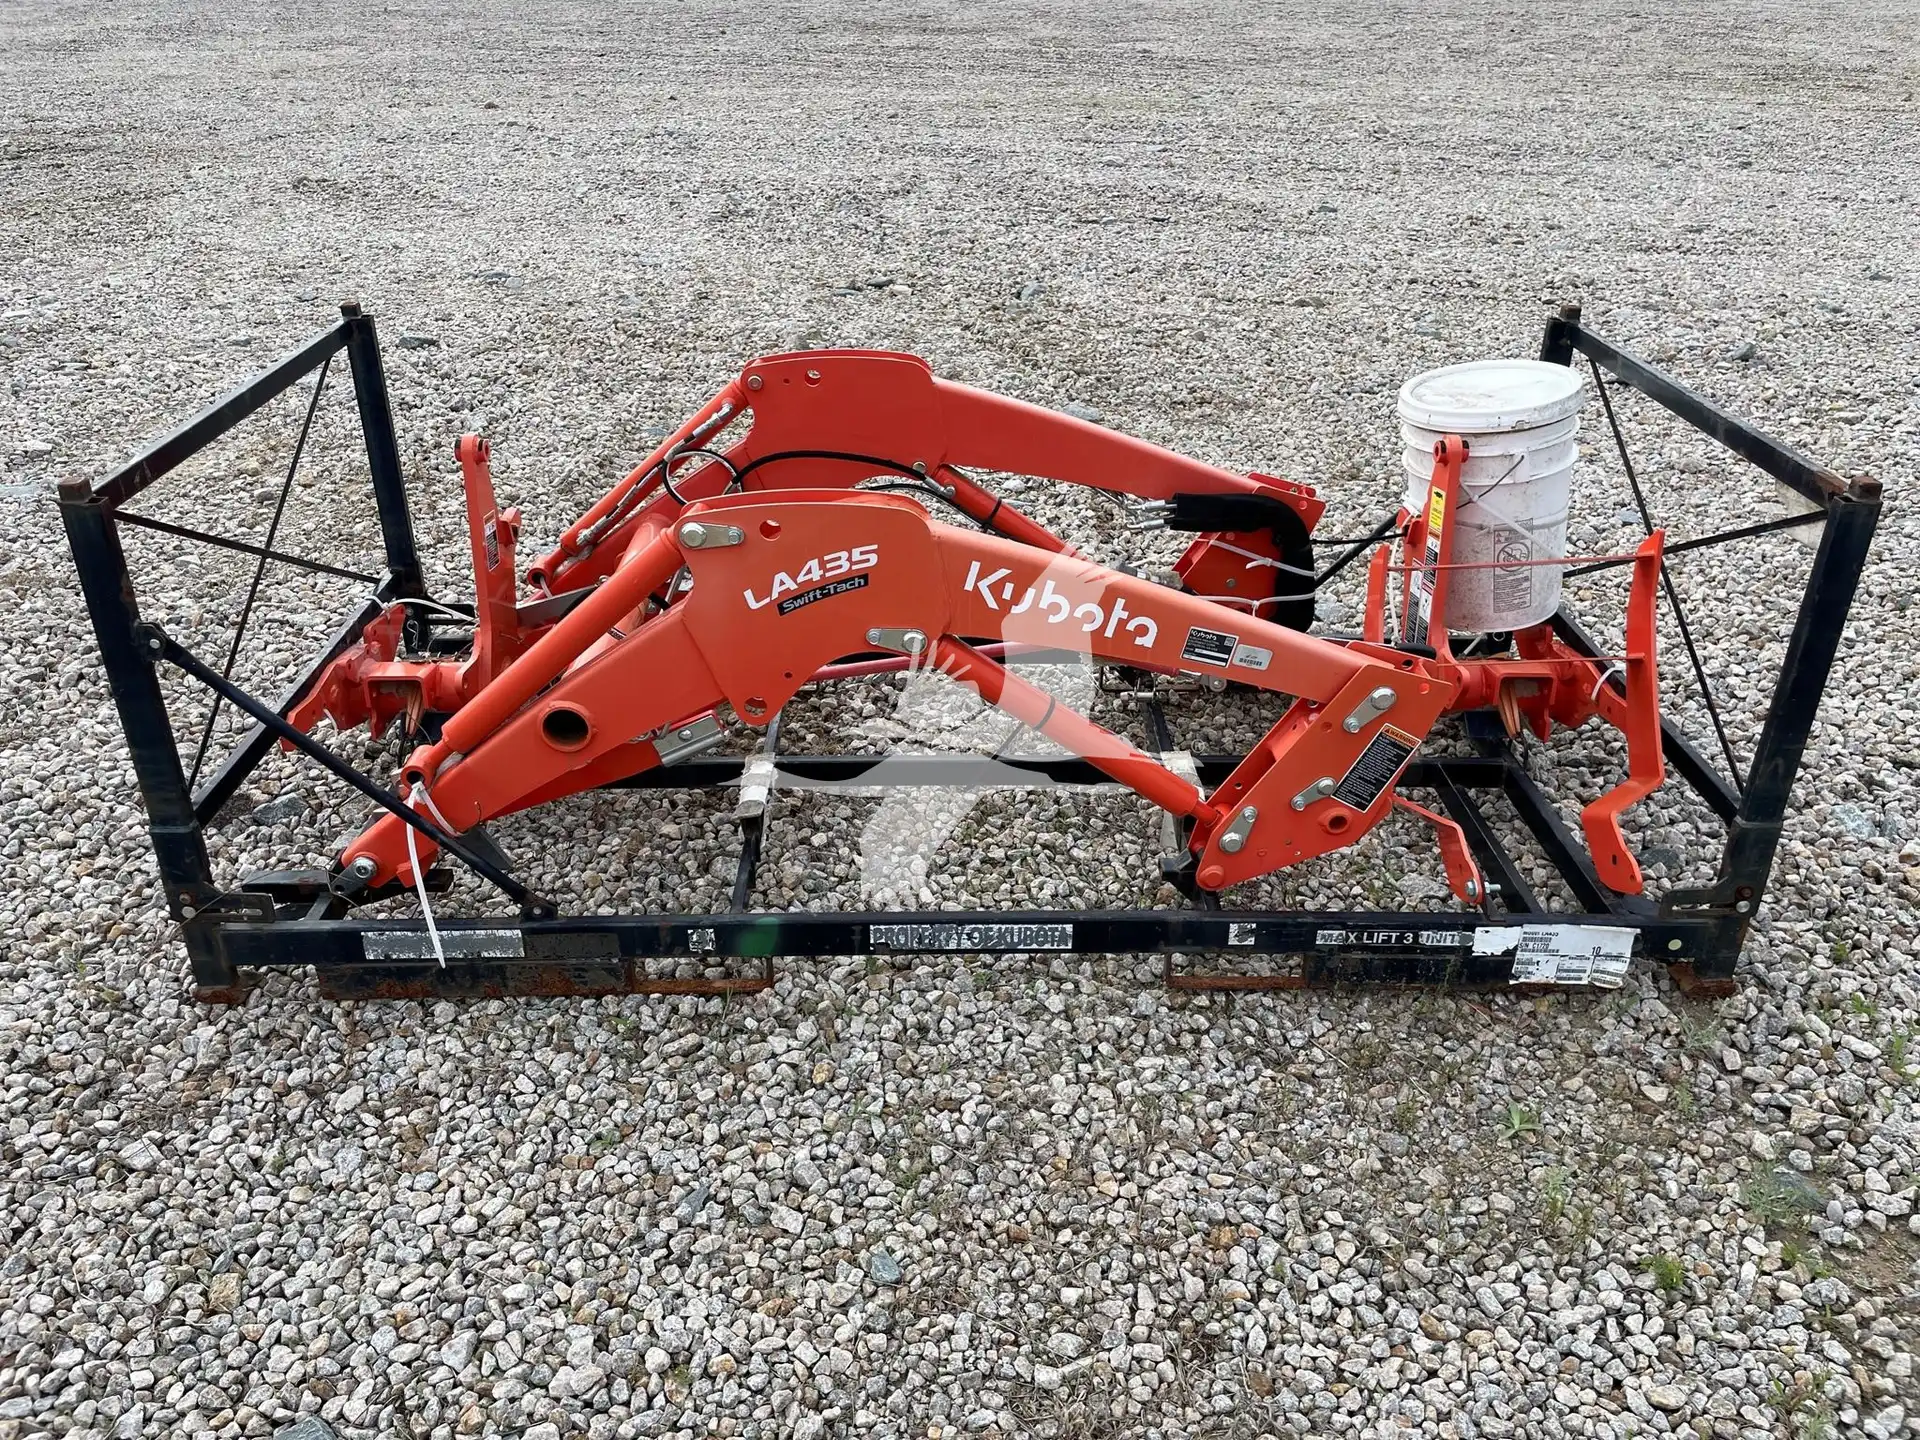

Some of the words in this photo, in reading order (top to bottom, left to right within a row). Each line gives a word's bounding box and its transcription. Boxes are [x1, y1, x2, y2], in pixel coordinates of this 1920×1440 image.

[743, 544, 879, 610] LA435
[782, 578, 865, 613] Swift-Tach
[963, 560, 1159, 649] Kubota
[1191, 630, 1218, 641] Kubota
[1389, 728, 1417, 747] WARNING
[998, 926, 1069, 948] KUBOTA
[1363, 932, 1400, 944] LIFT
[1403, 932, 1414, 945] 3
[1591, 946, 1602, 956] 10
